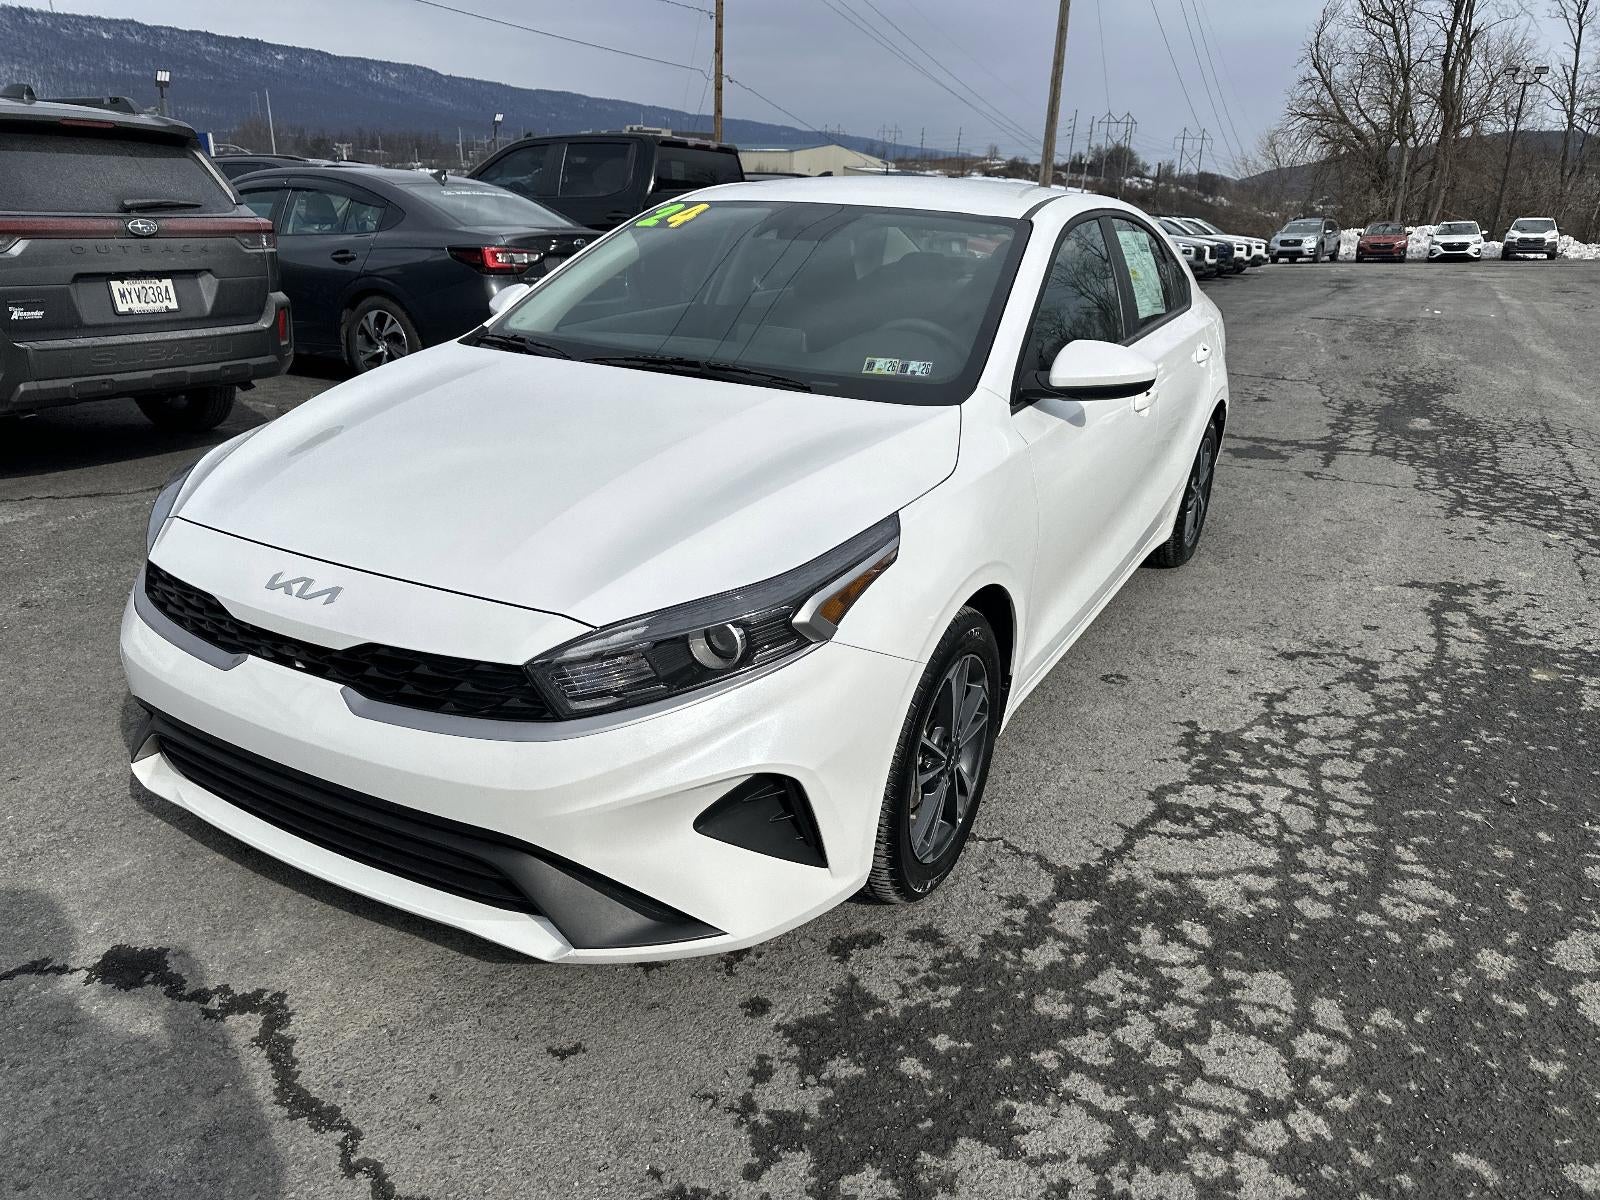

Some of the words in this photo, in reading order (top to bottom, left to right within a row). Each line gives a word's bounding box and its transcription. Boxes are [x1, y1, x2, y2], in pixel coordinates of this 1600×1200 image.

[635, 203, 710, 228] 24
[70, 244, 209, 255] OUTBACK
[118, 286, 171, 304] MYV2384
[91, 341, 233, 367] SUBARU
